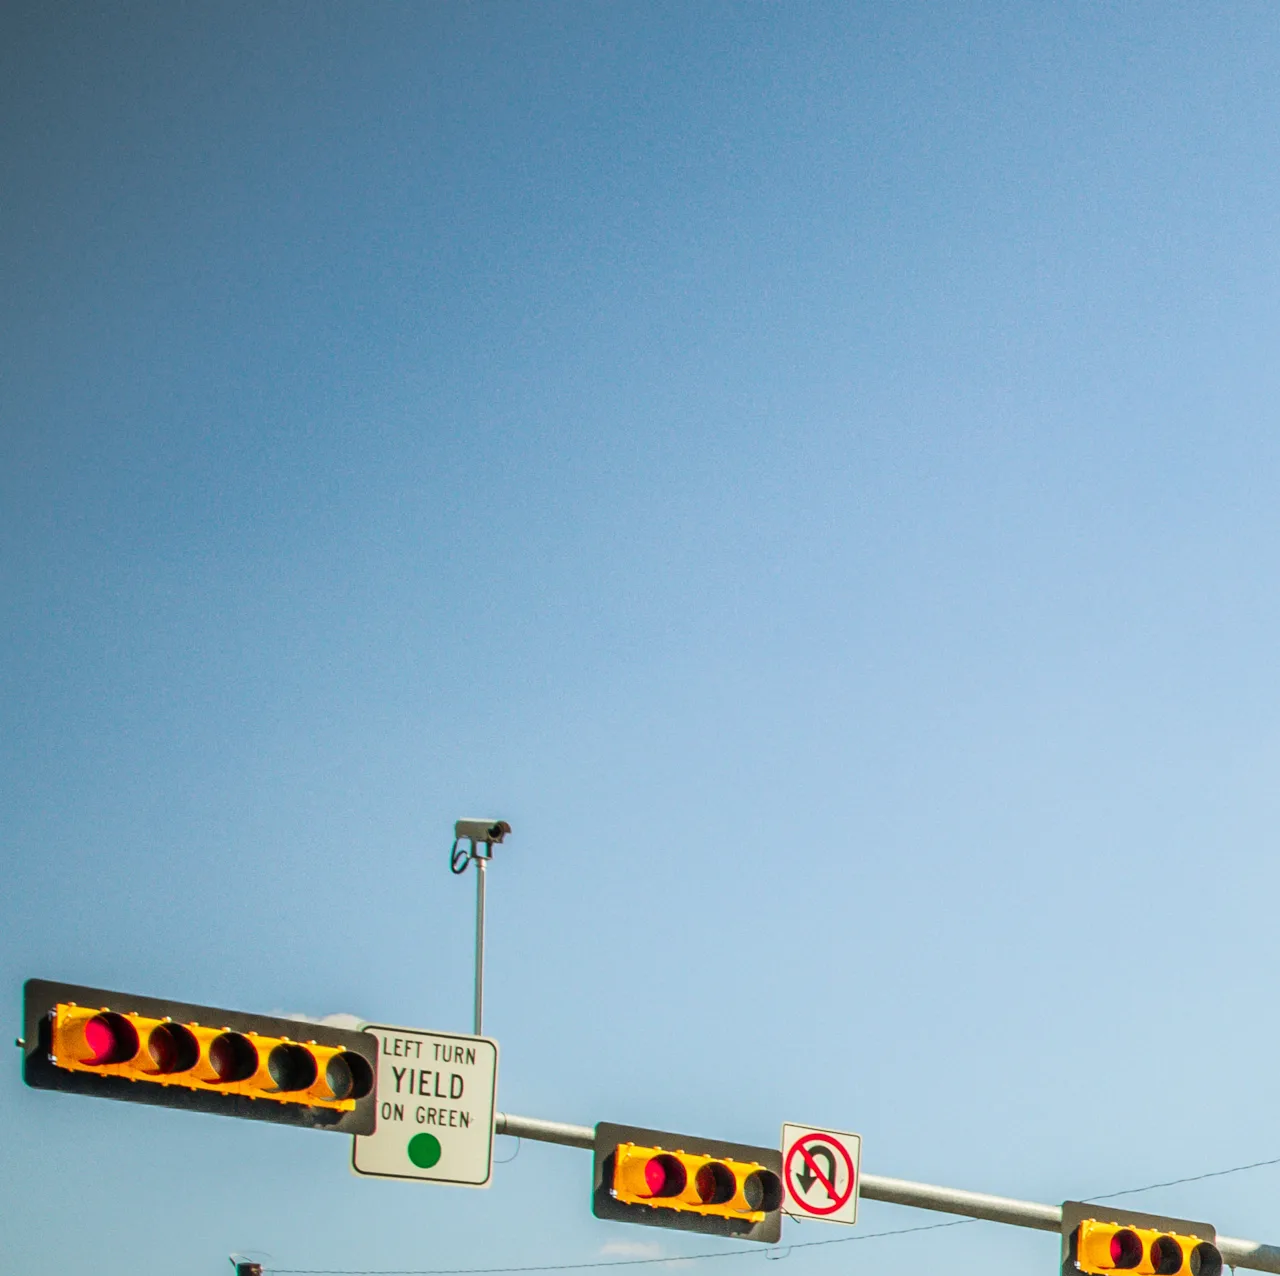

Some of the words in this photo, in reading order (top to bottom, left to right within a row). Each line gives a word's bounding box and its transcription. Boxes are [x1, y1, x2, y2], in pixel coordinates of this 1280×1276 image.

[383, 1036, 423, 1058] LEFT
[433, 1043, 476, 1065] TURN
[392, 1066, 464, 1099] YIELD
[381, 1102, 404, 1121] ON
[416, 1106, 470, 1128] GREEN
